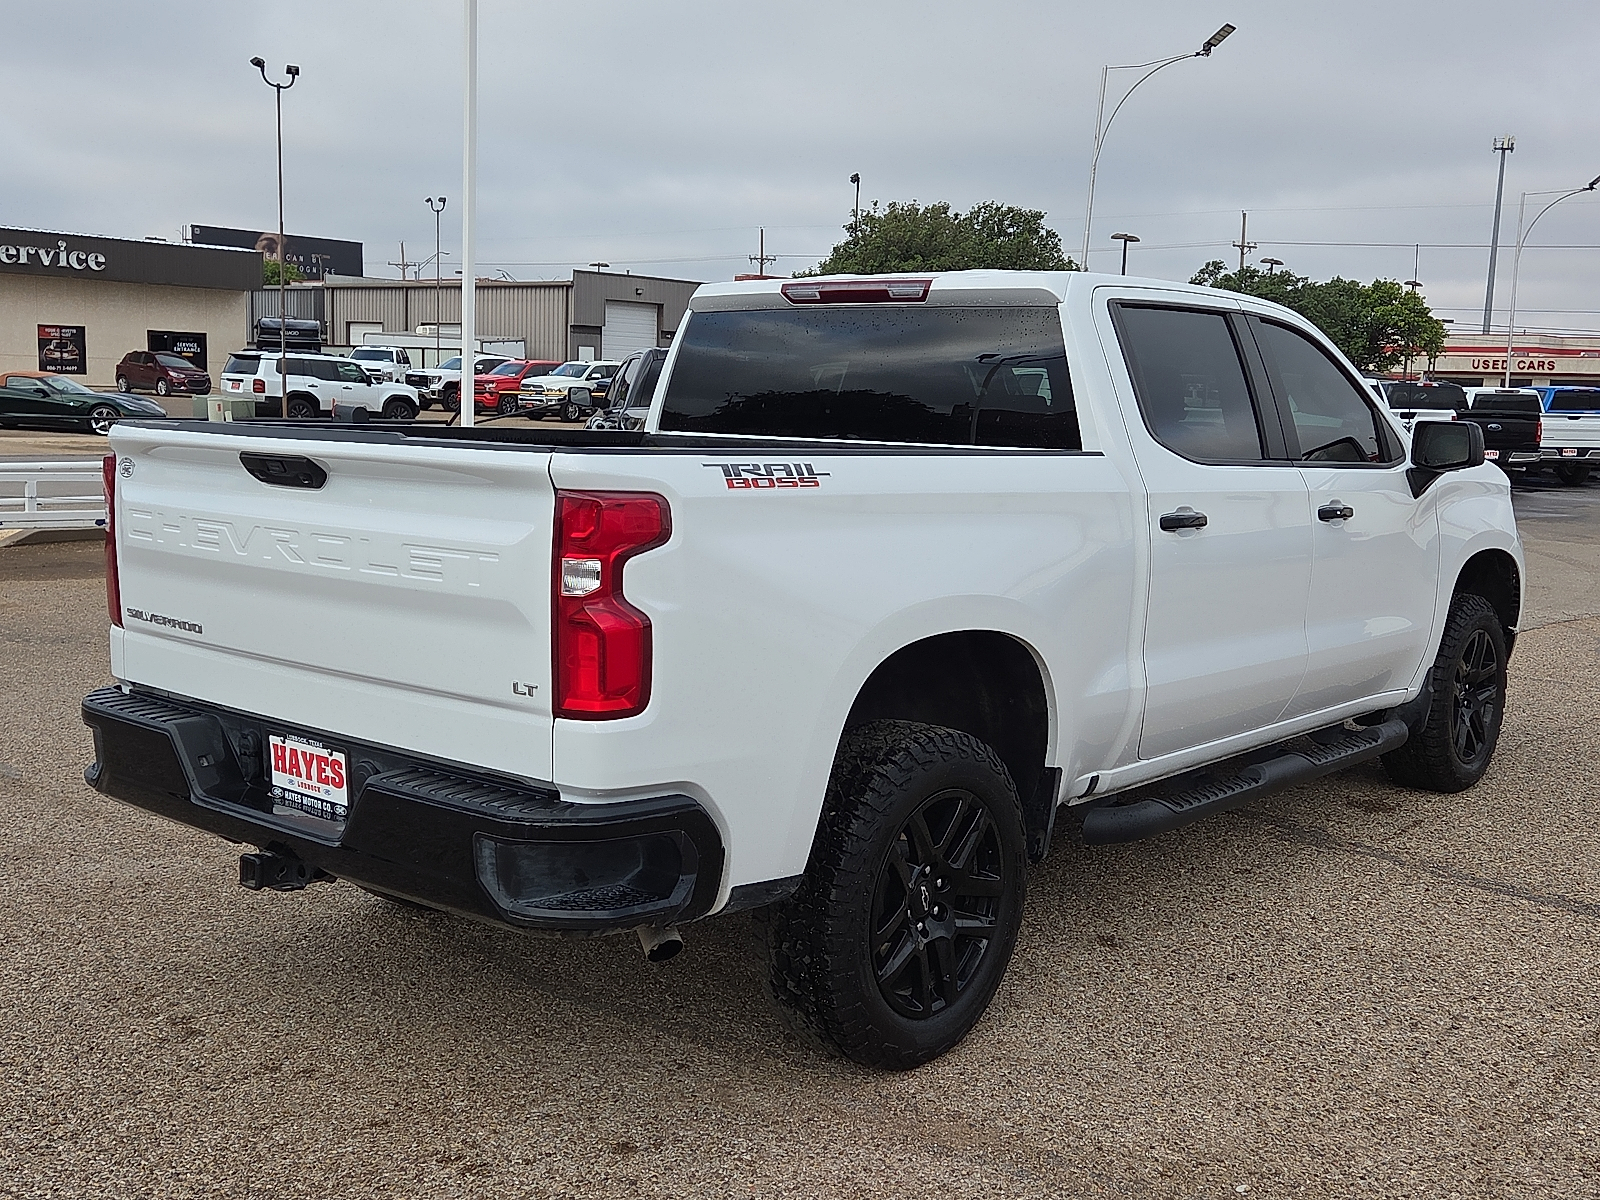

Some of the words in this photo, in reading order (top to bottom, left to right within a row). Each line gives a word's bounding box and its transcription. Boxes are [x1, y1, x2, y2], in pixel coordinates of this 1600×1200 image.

[298, 265, 337, 275] OGNZE
[1471, 359, 1508, 370] USED
[1517, 360, 1556, 371] CARS
[701, 463, 832, 477] TRAIL
[724, 476, 821, 490] BOSS
[126, 507, 500, 588] CHEVROLET
[126, 607, 203, 635] SILVERADO
[512, 680, 539, 698] LT
[308, 739, 323, 748] TEXAS
[271, 742, 345, 790] HAYES
[297, 780, 321, 794] LUBBOCK
[284, 790, 302, 803] HAYES
[302, 795, 322, 810] MOTOR
[322, 800, 334, 813] CO.
